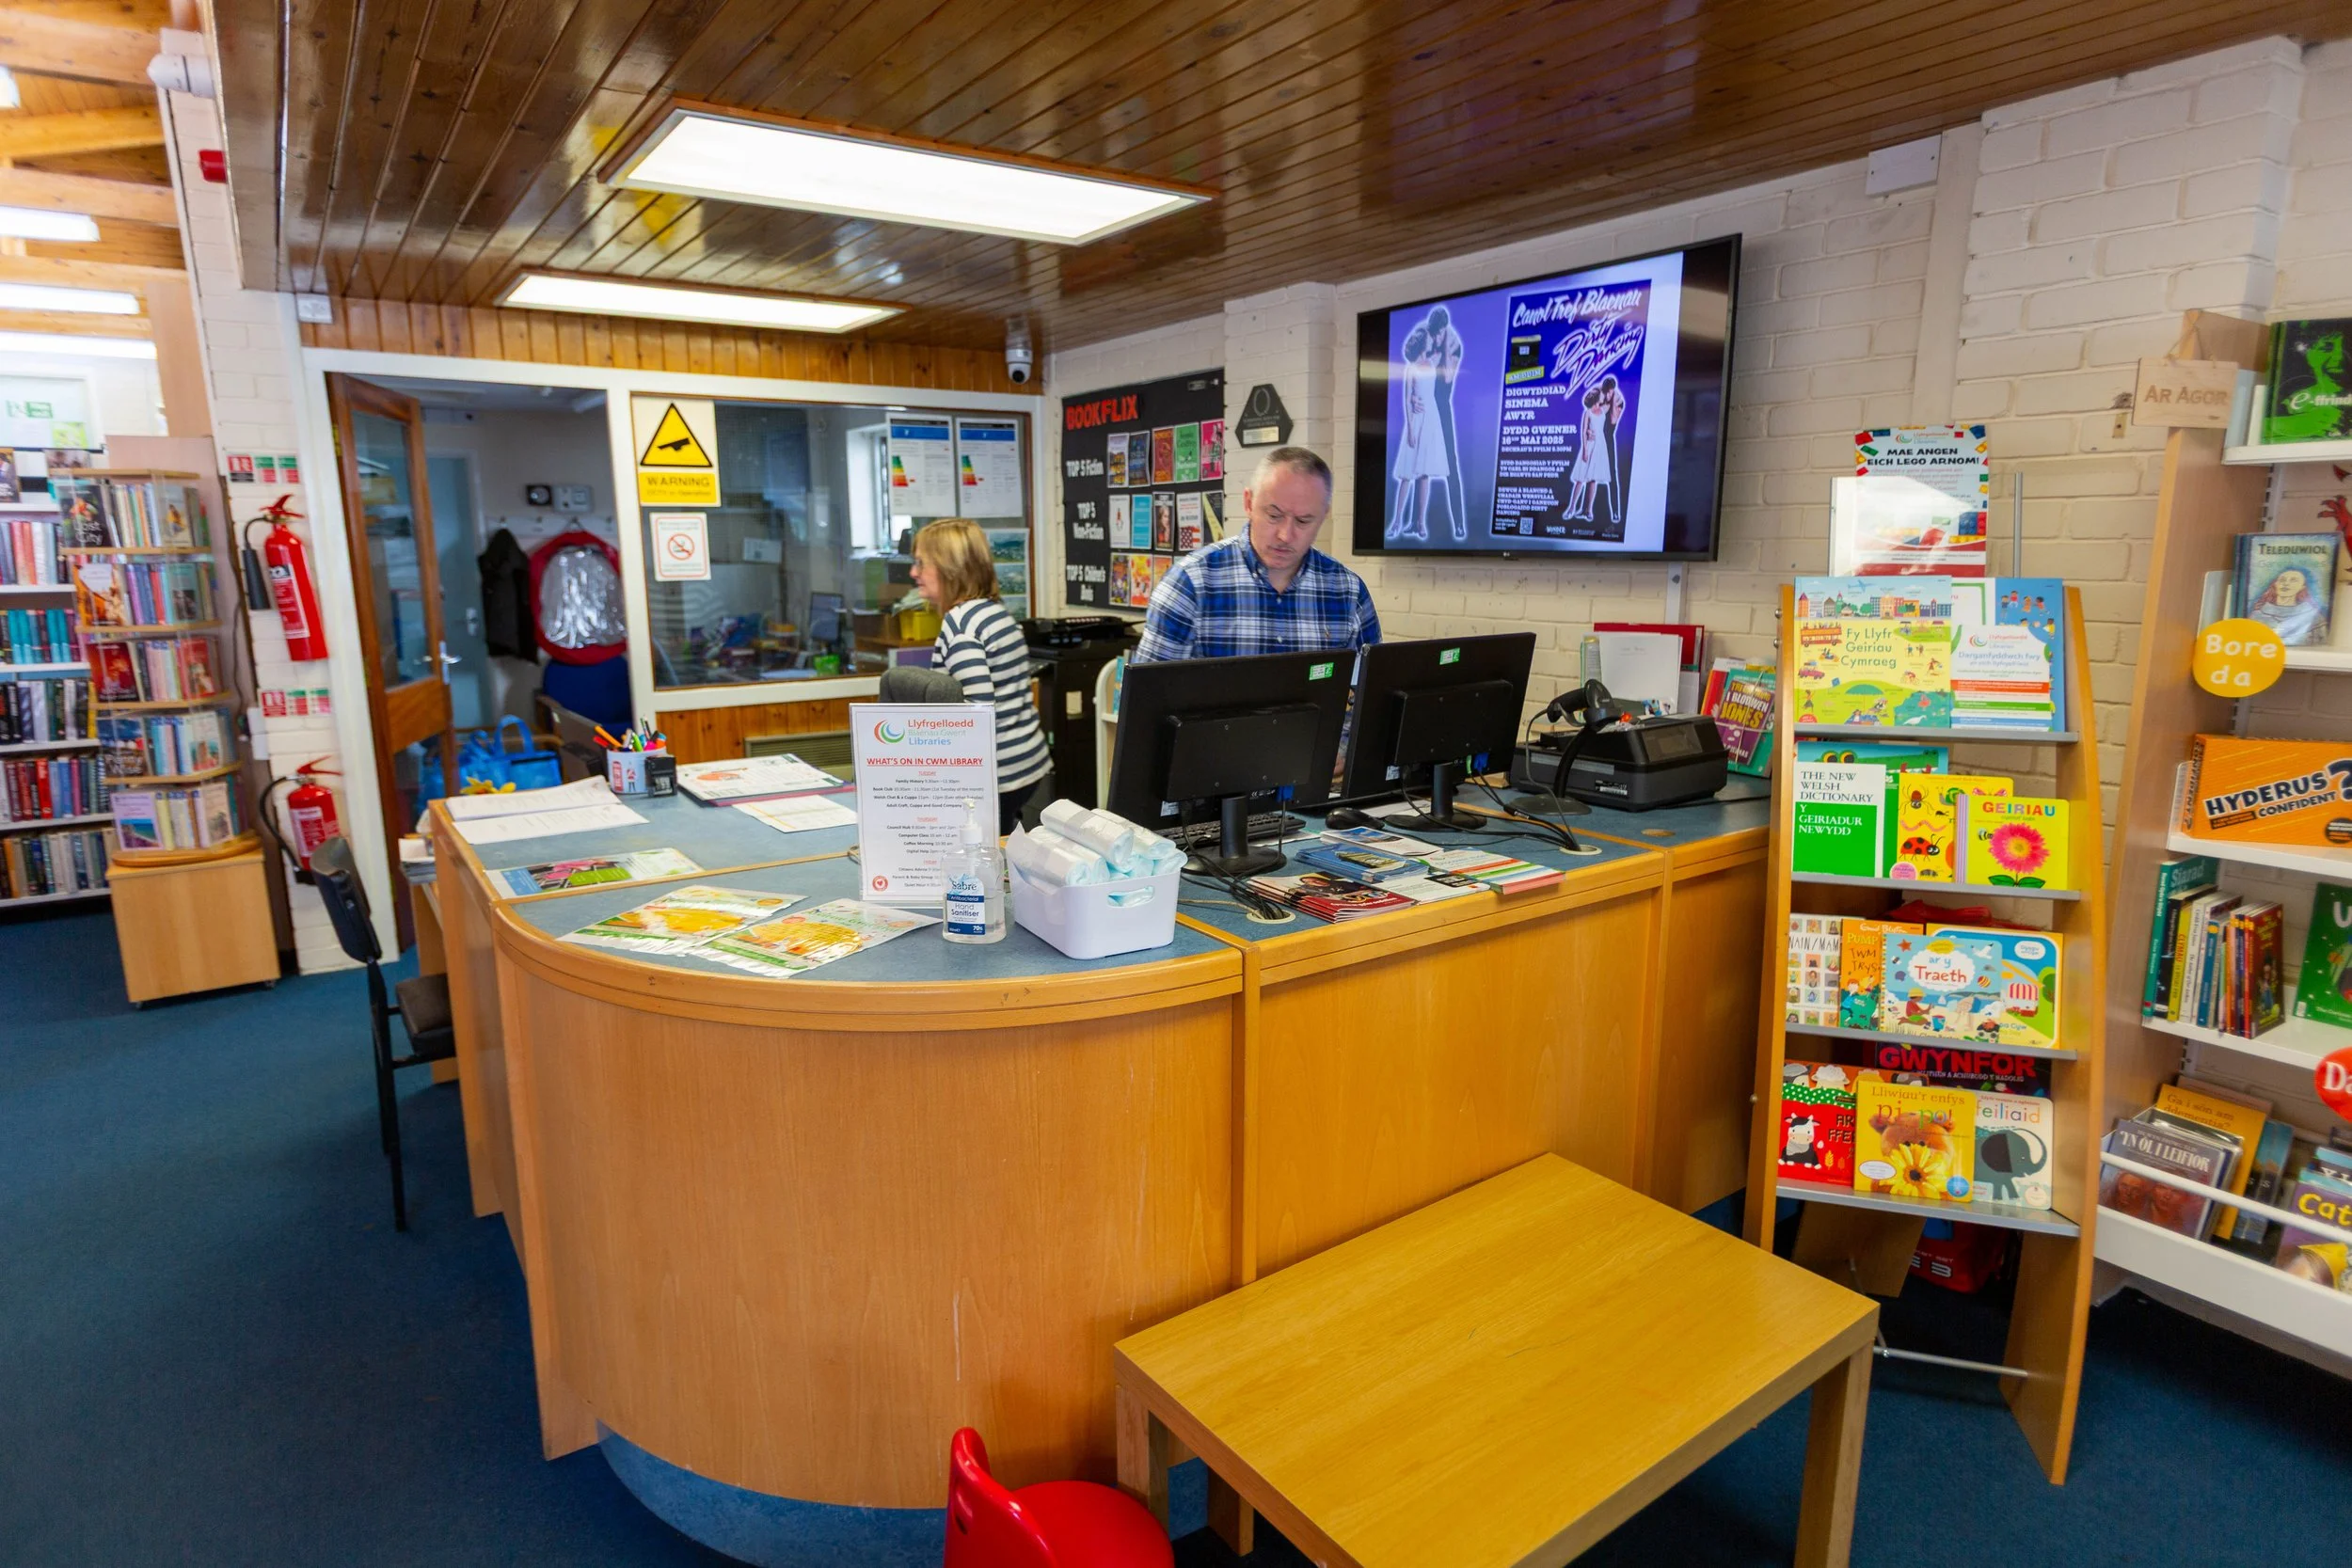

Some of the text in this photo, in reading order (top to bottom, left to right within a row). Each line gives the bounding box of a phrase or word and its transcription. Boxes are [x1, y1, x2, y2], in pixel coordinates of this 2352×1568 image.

[1513, 288, 1642, 327] Canol Tref Blaenau
[1550, 309, 1632, 378] Dirty
[1564, 323, 1645, 401] Dancing
[1506, 386, 1565, 396] DIGWYDDIAD
[2144, 385, 2229, 405] AR AGOR
[1505, 398, 1549, 408] SINEMA
[1066, 394, 1139, 430] BOOKFLIX
[1504, 410, 1535, 420] AWYR
[1502, 424, 1577, 435] DYDD GWENER
[1520, 435, 1564, 444] MAI 2025
[1066, 461, 1081, 477] TOP
[1086, 458, 1104, 476] Fiction
[1930, 457, 1979, 466] ARNOM!
[647, 477, 710, 487] WARNING
[1077, 502, 1089, 519] TOP
[75, 532, 103, 546] City
[2258, 544, 2328, 555] TELEDUWIOL
[1066, 565, 1078, 581] TOP
[1847, 627, 1893, 641] Fy Llyfr
[1846, 641, 1892, 652] Geiriau
[2205, 634, 2278, 658] Bore
[1840, 656, 1897, 669] Cymraeg
[2211, 665, 2251, 687] da
[1731, 692, 1769, 712] BLODWEN
[1720, 703, 1764, 729] JONES
[908, 719, 974, 729] Llyfrgelloedd
[1801, 770, 1856, 782] THE NEW
[1801, 782, 1841, 791] WELSH
[1801, 792, 1874, 802] DICTIONARY
[2259, 791, 2337, 816] CONFIDENT
[1800, 804, 1807, 813] Y
[1982, 801, 2056, 816] GEIRIAU
[1799, 815, 1862, 826] GEIRIADUR
[1798, 825, 1851, 835] NEWYDD
[2171, 860, 2205, 888] Siarad
[952, 880, 977, 891] Sabre
[1847, 933, 1878, 945] PUMP
[1851, 947, 1877, 959] TWM
[1852, 960, 1881, 973] TRYS
[1929, 956, 1951, 968] ar y
[1915, 966, 1967, 983] Traeth
[1879, 1045, 2036, 1077] GWYNFOR
[1931, 1090, 1965, 1106] enfys
[1976, 1099, 2041, 1124] feiliaid
[2167, 1093, 2184, 1106] Ga
[2215, 1111, 2234, 1121] am
[2164, 1104, 2232, 1129] ddementia?
